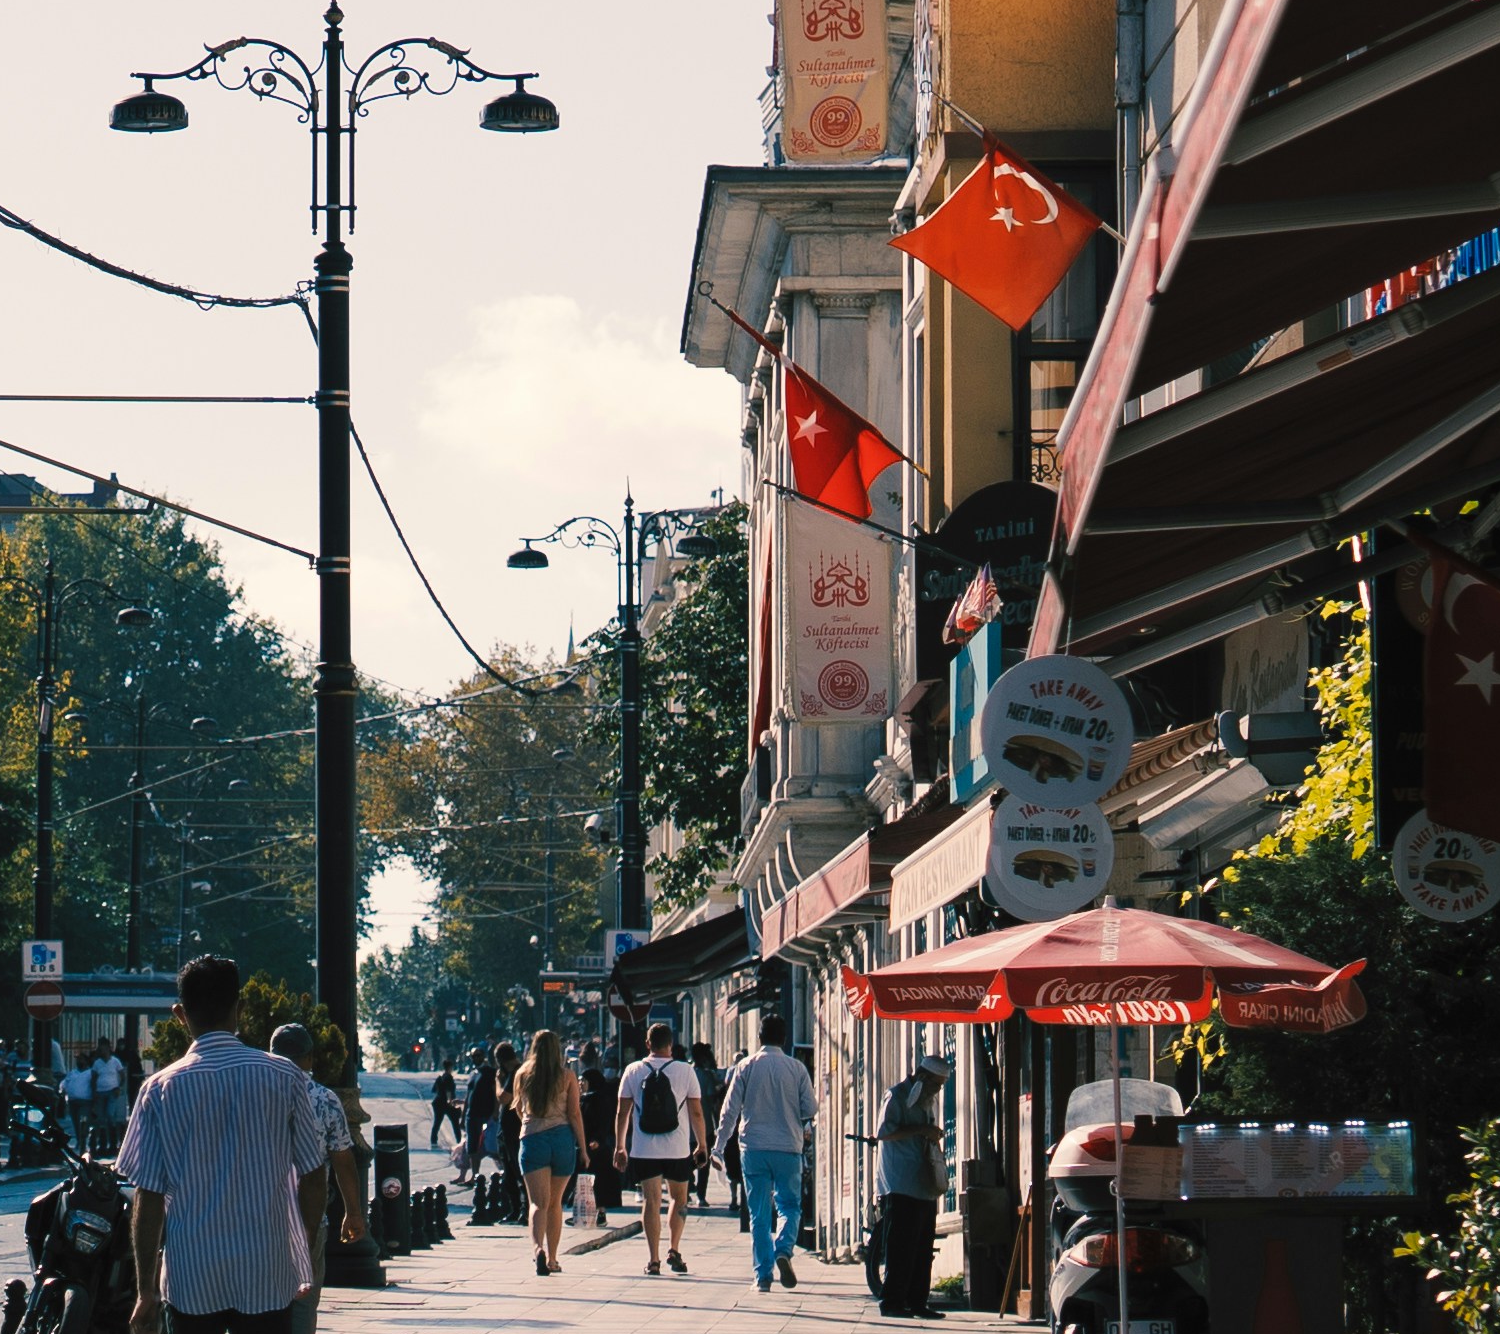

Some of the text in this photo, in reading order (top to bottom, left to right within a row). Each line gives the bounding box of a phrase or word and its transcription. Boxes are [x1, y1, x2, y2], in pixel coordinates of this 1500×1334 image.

[796, 56, 876, 73] Sultanahmet
[808, 71, 865, 89] Köftecisi
[974, 517, 1036, 543] TARİHİ
[802, 622, 880, 639] Sultanahmet
[814, 637, 870, 654] Köftecisi
[1030, 679, 1105, 712] TAKE AWAY
[1005, 701, 1031, 723] PAKET
[1007, 824, 1026, 843] PAKET
[919, 824, 983, 910] RESTAURANT
[1412, 882, 1490, 913] TAKE AWAY
[30, 964, 56, 973] EDS
[887, 984, 987, 1003] TADINI ÇIKAR
